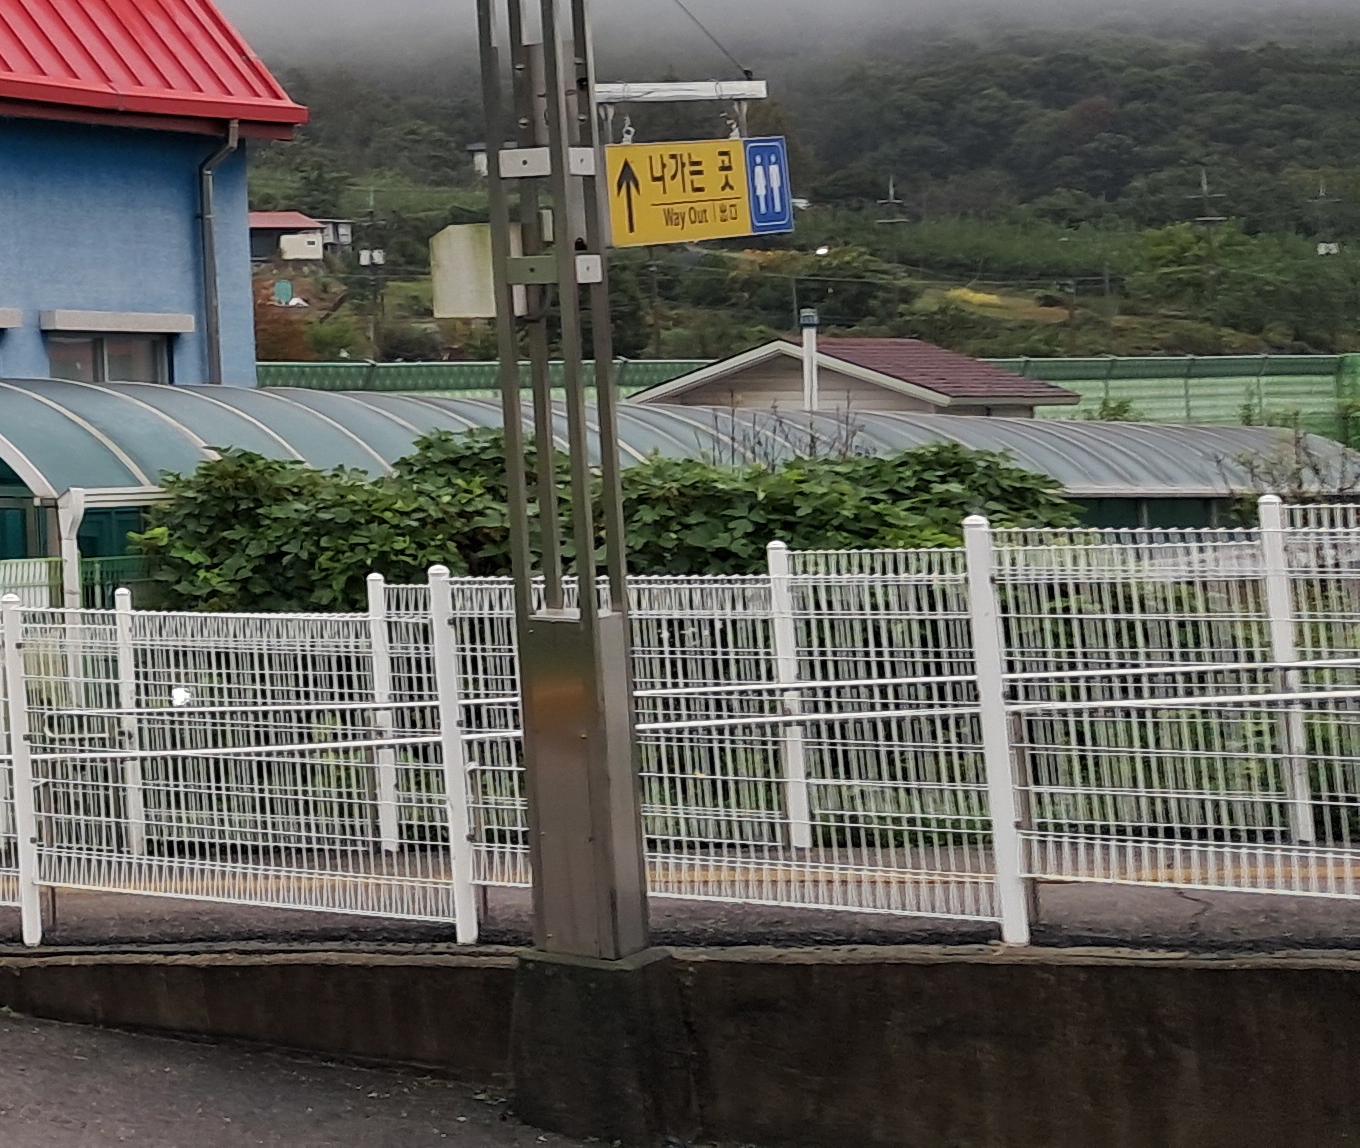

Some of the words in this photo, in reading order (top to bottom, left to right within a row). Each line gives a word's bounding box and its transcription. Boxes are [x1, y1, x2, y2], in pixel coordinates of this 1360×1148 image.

[648, 152, 706, 195] 나가는
[717, 150, 735, 192] 곳
[663, 207, 686, 231] Way
[688, 206, 709, 225] Out
